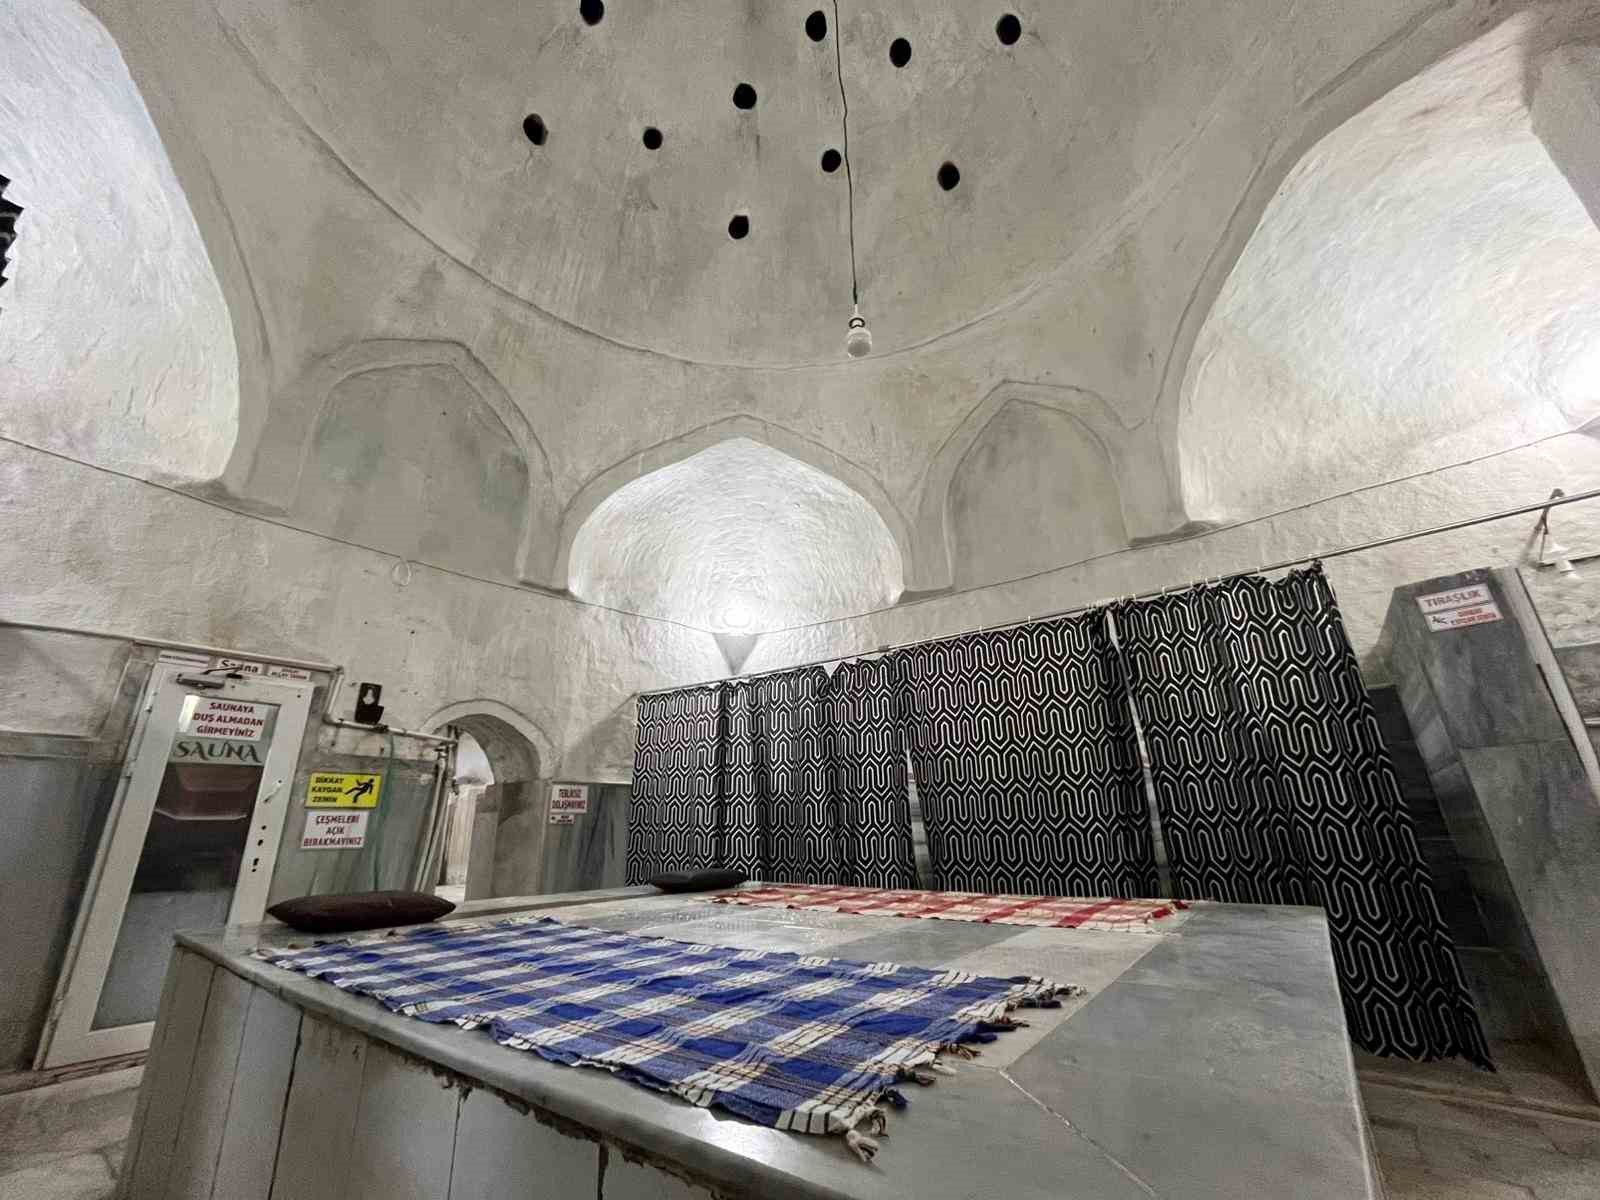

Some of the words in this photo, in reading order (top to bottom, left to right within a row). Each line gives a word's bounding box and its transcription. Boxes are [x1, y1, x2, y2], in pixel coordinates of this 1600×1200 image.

[209, 702, 254, 714] SAUNAYA
[216, 715, 264, 726] ALMADAN
[177, 741, 263, 763] SAUNA
